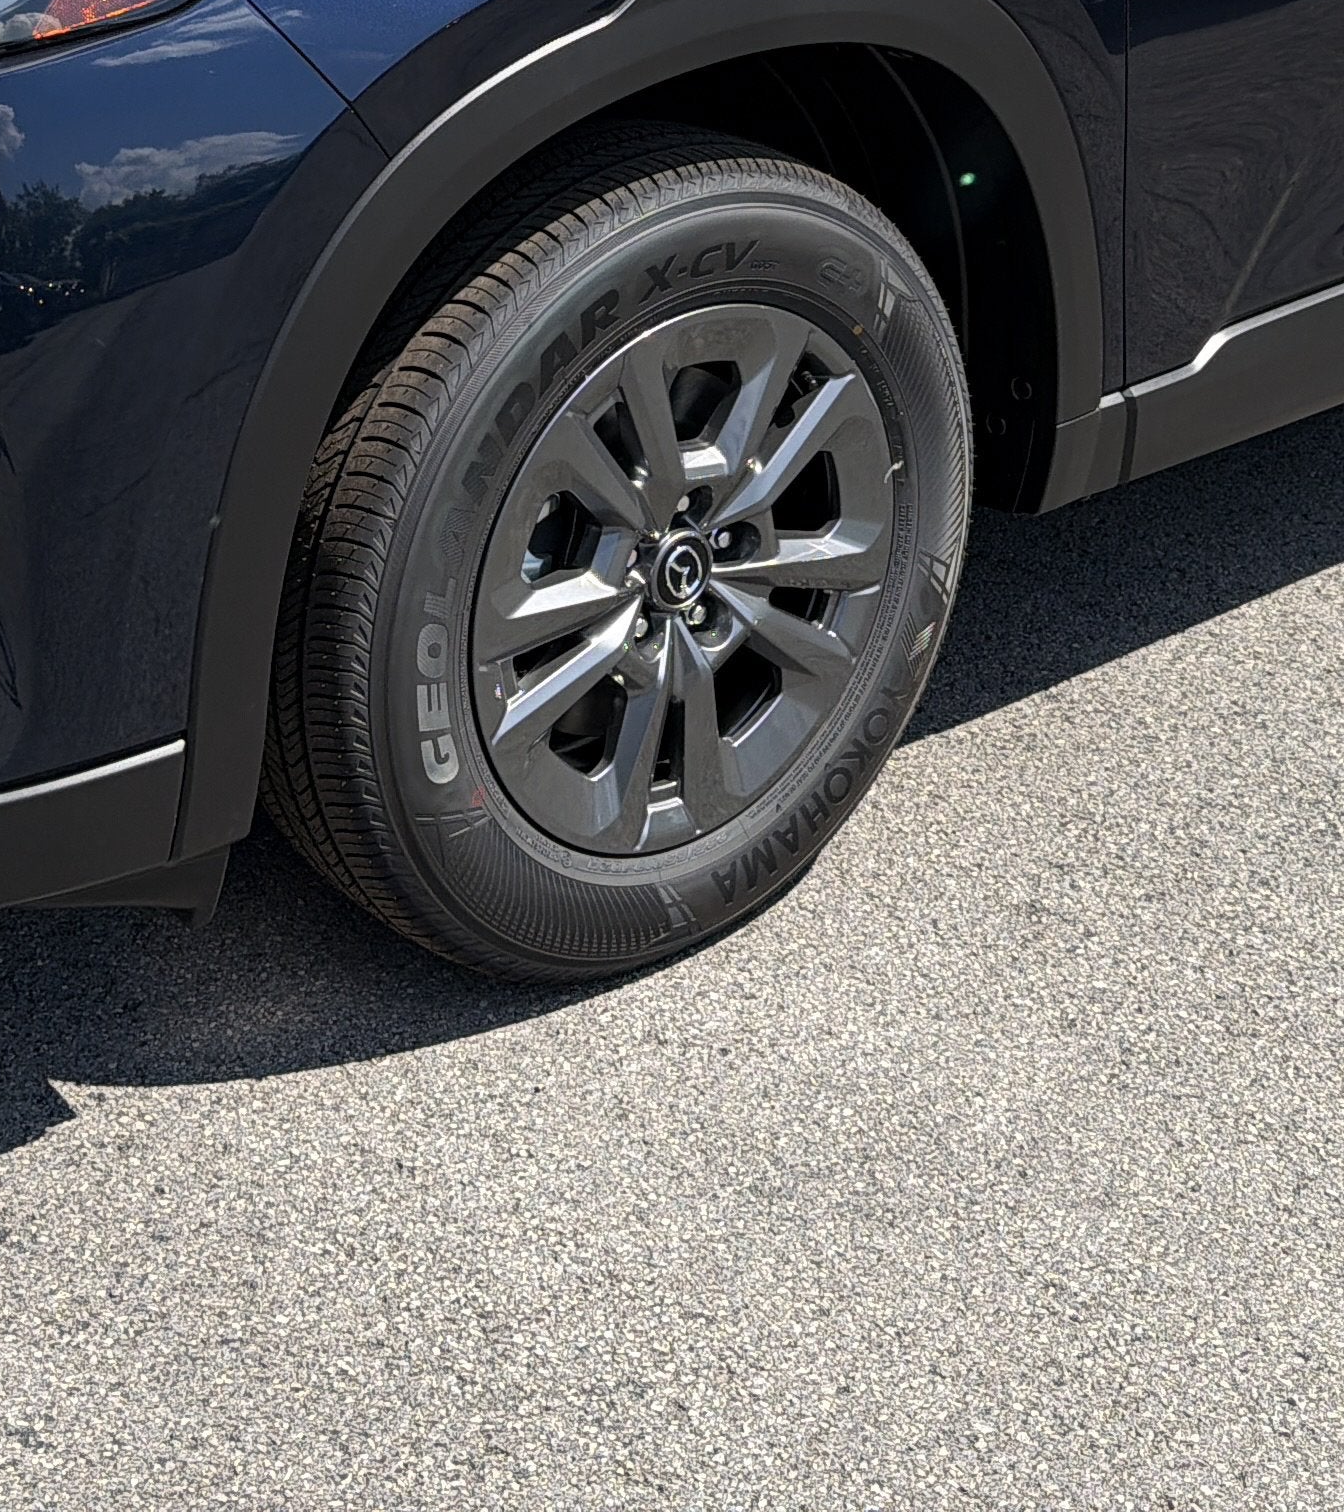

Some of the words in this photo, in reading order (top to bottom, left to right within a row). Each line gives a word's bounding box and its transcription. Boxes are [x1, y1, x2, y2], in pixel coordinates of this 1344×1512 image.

[416, 289, 623, 784] GEOLANDAR
[639, 240, 760, 306] X-CV
[710, 686, 910, 906] YOKOHAMA
